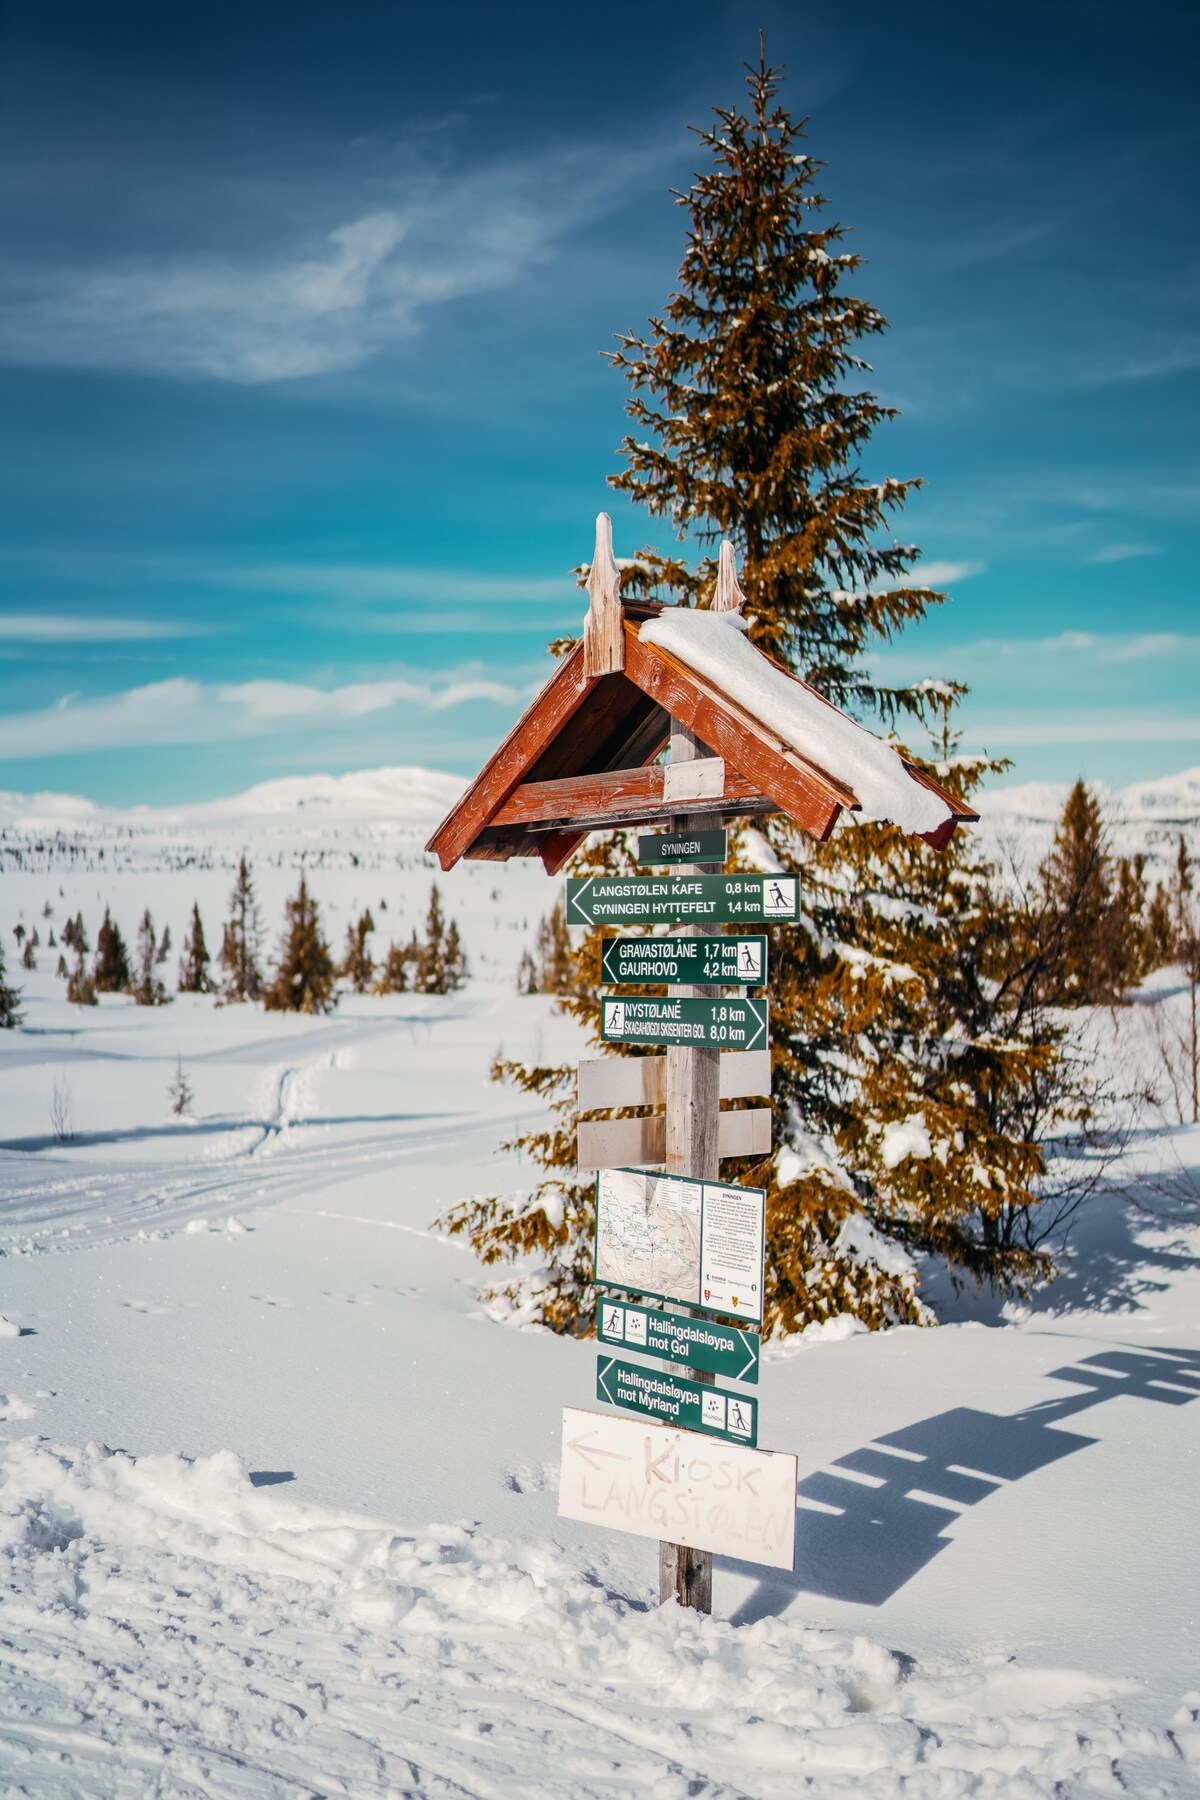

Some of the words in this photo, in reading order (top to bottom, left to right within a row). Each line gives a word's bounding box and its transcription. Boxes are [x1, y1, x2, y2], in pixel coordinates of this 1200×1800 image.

[661, 841, 700, 856] SYNINGEN
[592, 885, 668, 897] LANGSTØLEN
[671, 883, 702, 895] KAFE
[725, 882, 743, 895] 0,8
[744, 882, 760, 893] km
[592, 903, 649, 915] SYNINGEN
[652, 901, 716, 914] HYTTEFELT
[727, 901, 742, 914] 1,4
[744, 901, 760, 912] km
[704, 943, 720, 960] 1,7
[721, 943, 737, 958] km
[619, 962, 678, 976] GAURHOVD
[703, 962, 720, 979] 4,2
[721, 962, 737, 977] km
[625, 1003, 682, 1019] NYSTØLANE
[711, 1006, 727, 1023] 1,8
[729, 1007, 746, 1022] km
[660, 1021, 692, 1038] SKISENTER
[692, 1023, 706, 1039] GOL
[710, 1025, 727, 1042] 8,0
[729, 1026, 745, 1041] km
[648, 1316, 735, 1352] Hallingdalsløypa
[648, 1336, 669, 1352] mot
[670, 1339, 689, 1357] Gol
[617, 1368, 700, 1405] Hallingdalsløypa
[617, 1387, 637, 1405] mot
[638, 1391, 679, 1416] Myrland
